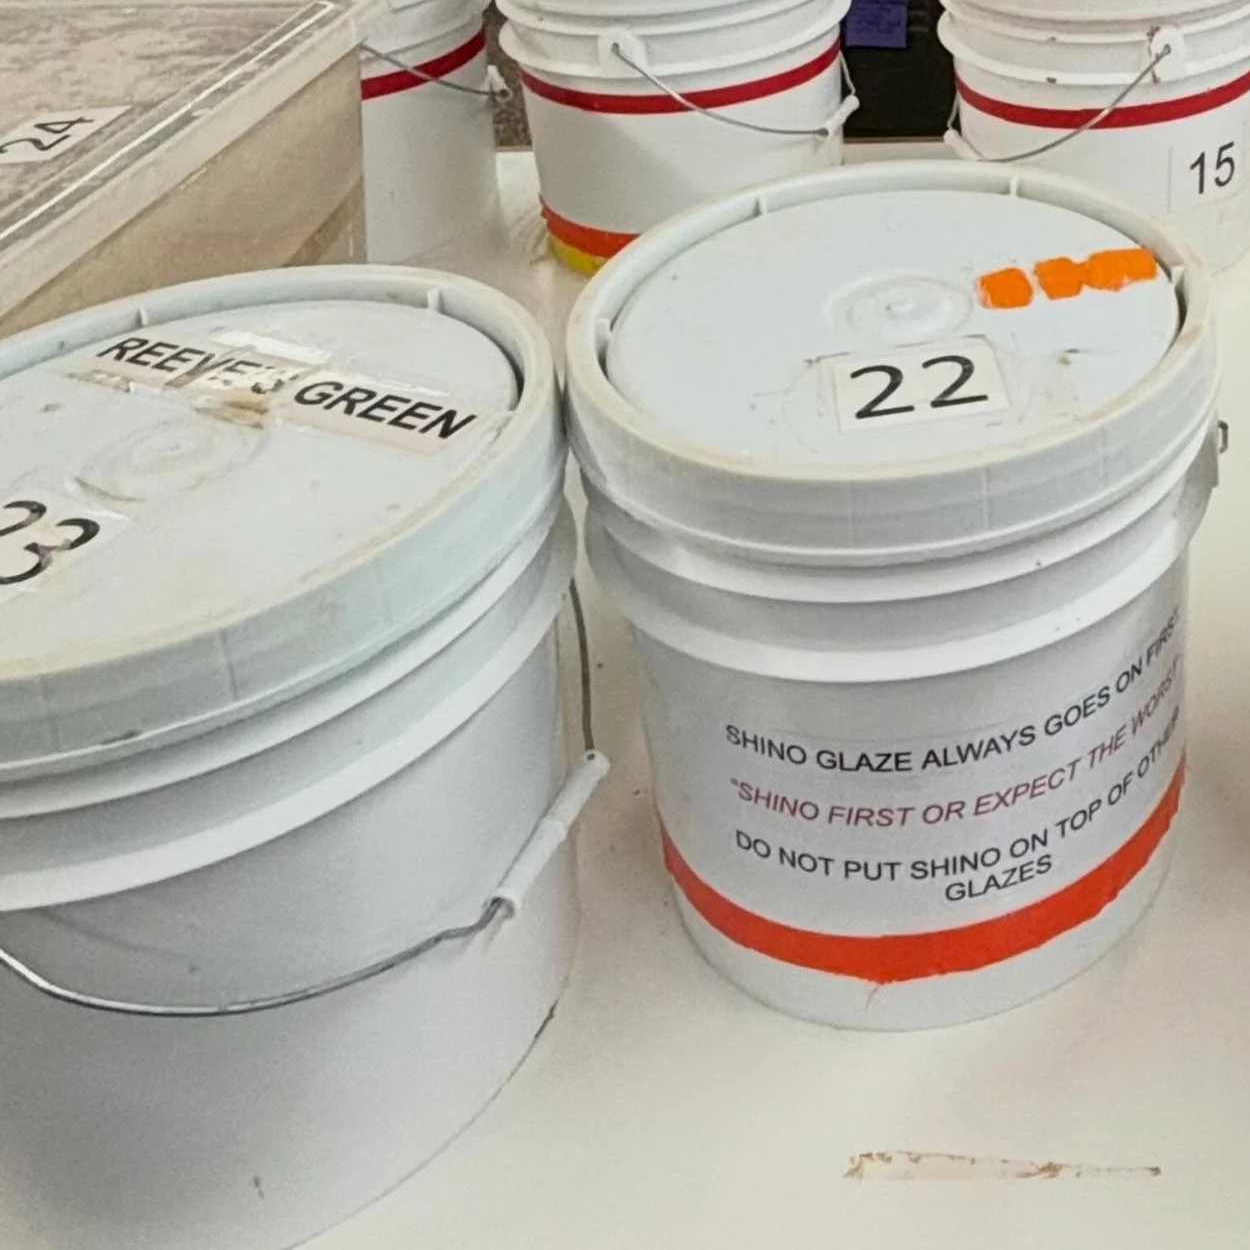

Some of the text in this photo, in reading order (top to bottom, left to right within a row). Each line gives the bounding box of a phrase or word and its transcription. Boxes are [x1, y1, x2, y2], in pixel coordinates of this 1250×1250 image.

[0, 116, 95, 155] 24
[1189, 141, 1235, 195] 15
[294, 381, 478, 439] GREEN
[850, 355, 988, 419] 22
[725, 725, 807, 766] SHINO
[816, 749, 913, 772] GLAZE
[920, 725, 1037, 770] ALWAYS
[1044, 686, 1110, 737] GOES
[1115, 655, 1143, 694] ON
[828, 805, 915, 827] FIRST
[922, 800, 965, 825] OR
[972, 760, 1081, 817] EXPECT
[1086, 723, 1127, 769] THE
[736, 829, 771, 858] DO
[778, 846, 834, 877] NOT
[844, 861, 902, 881] PUT
[910, 846, 1001, 879] SHINO
[1008, 829, 1050, 858] ON
[1055, 798, 1102, 839] TOP
[1107, 771, 1135, 807] OF
[945, 854, 1052, 902] GLAZES
